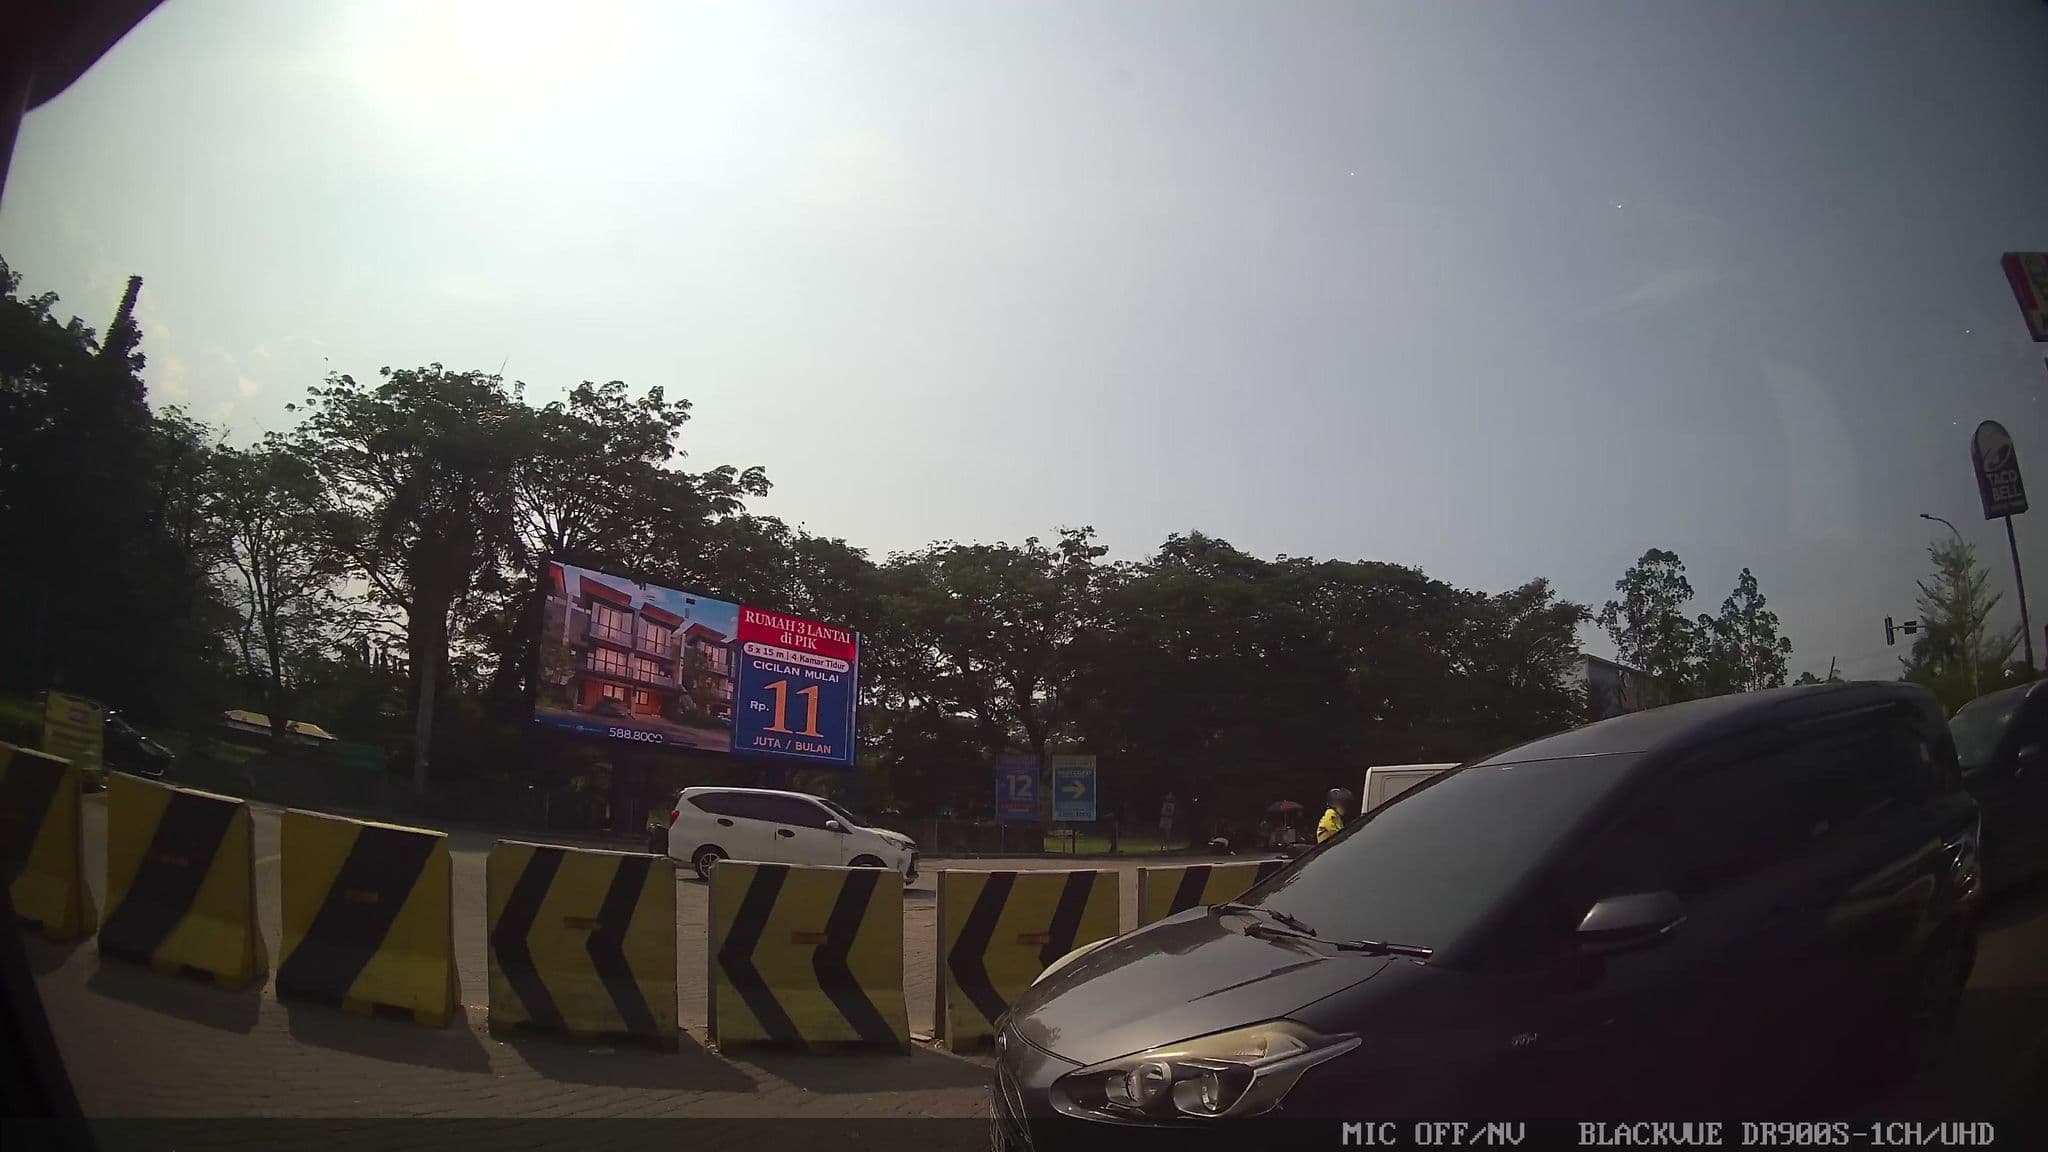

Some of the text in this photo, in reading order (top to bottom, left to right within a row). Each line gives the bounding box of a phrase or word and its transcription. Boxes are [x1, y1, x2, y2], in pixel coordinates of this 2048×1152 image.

[1986, 469, 2017, 487] TACO
[1992, 484, 2023, 502] BELL
[744, 610, 851, 644] RUMAH 3 LANTAI
[780, 631, 818, 650] di PIK
[747, 644, 754, 652] 5
[763, 647, 774, 656] 15
[799, 654, 824, 667] Kamar
[826, 659, 846, 670] Tidur
[753, 660, 839, 683] CICILAN MULAI
[750, 679, 824, 738] Rp. 11
[753, 736, 782, 749] JUTA
[795, 741, 832, 754] BULAN
[1006, 774, 1033, 798] 12
